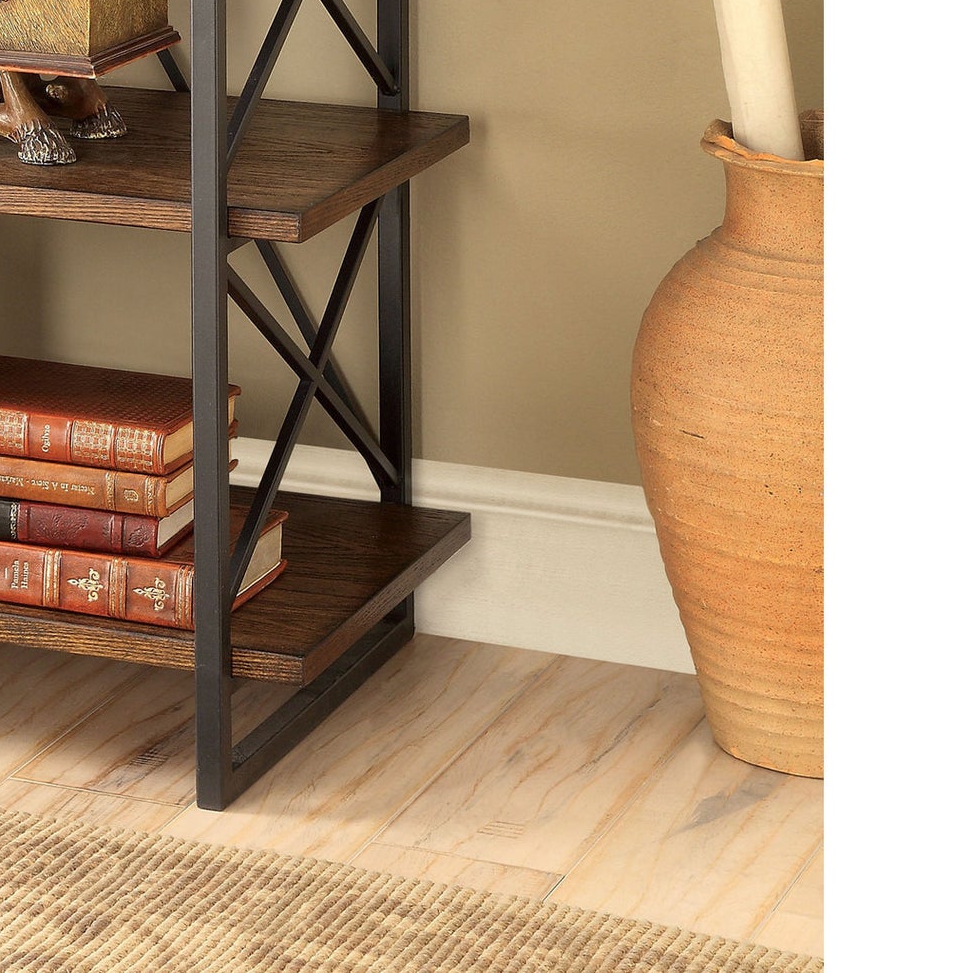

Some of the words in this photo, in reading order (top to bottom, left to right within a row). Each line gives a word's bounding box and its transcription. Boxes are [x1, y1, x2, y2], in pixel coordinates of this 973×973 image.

[31, 479, 49, 490] Sieve
[51, 481, 58, 490] A
[60, 482, 69, 492] In
[71, 483, 96, 496] Nectar
[10, 560, 19, 589] Pamela
[20, 562, 29, 589] Haines
